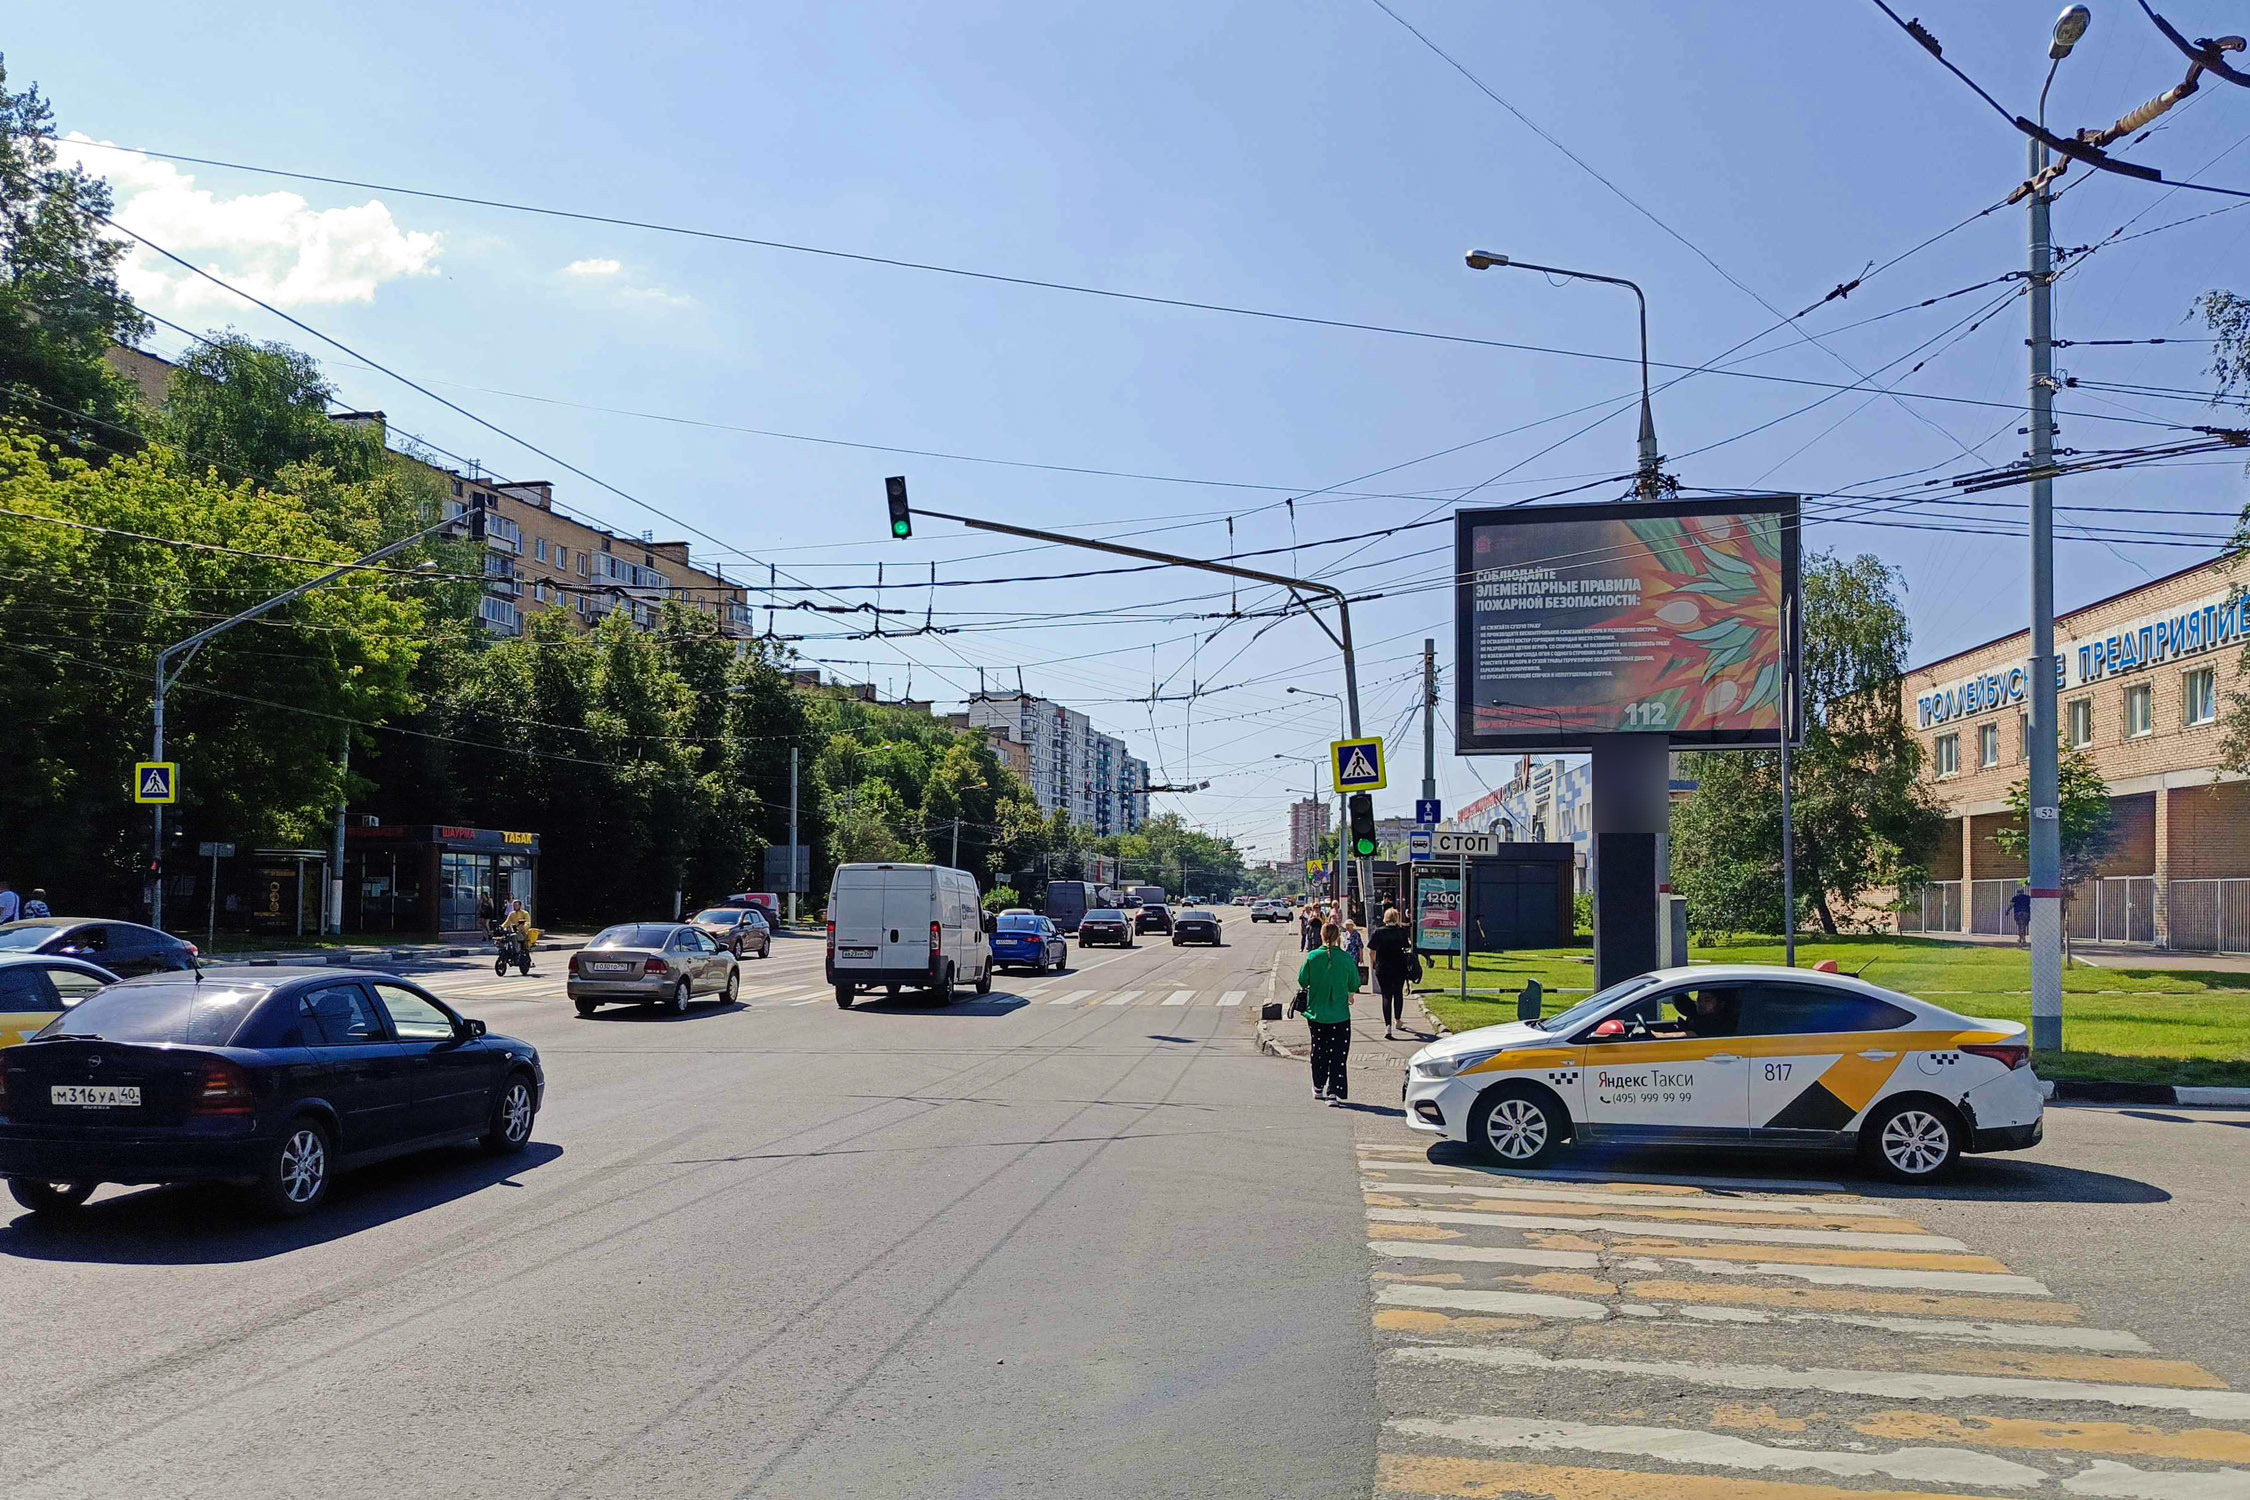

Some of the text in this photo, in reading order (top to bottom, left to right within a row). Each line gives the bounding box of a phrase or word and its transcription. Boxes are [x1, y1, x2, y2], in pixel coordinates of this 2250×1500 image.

[1476, 567, 1556, 582] СОБЛЮДАЙТЕ
[1476, 578, 1641, 597] ЭЛЕМЕНТАРНЫЕ ПРАВИЛА
[1476, 594, 1641, 612] ПОЖАРНОЙ БЕЗОПАСНОСТИ:
[1918, 593, 2250, 726] ТРОЛЛЕЙБУСЕ ПРЕДПРИЯТИЕ
[1624, 702, 1667, 726] 112
[2041, 808, 2053, 818] 52
[442, 828, 475, 839] ШАУРМА
[504, 832, 532, 844] ТАБАК
[1440, 835, 1489, 851] СТОП
[1599, 1070, 1694, 1089] Яндекс Такси
[1764, 1063, 1793, 1082] 817
[1612, 1092, 1692, 1104] (495) 999 99 99
